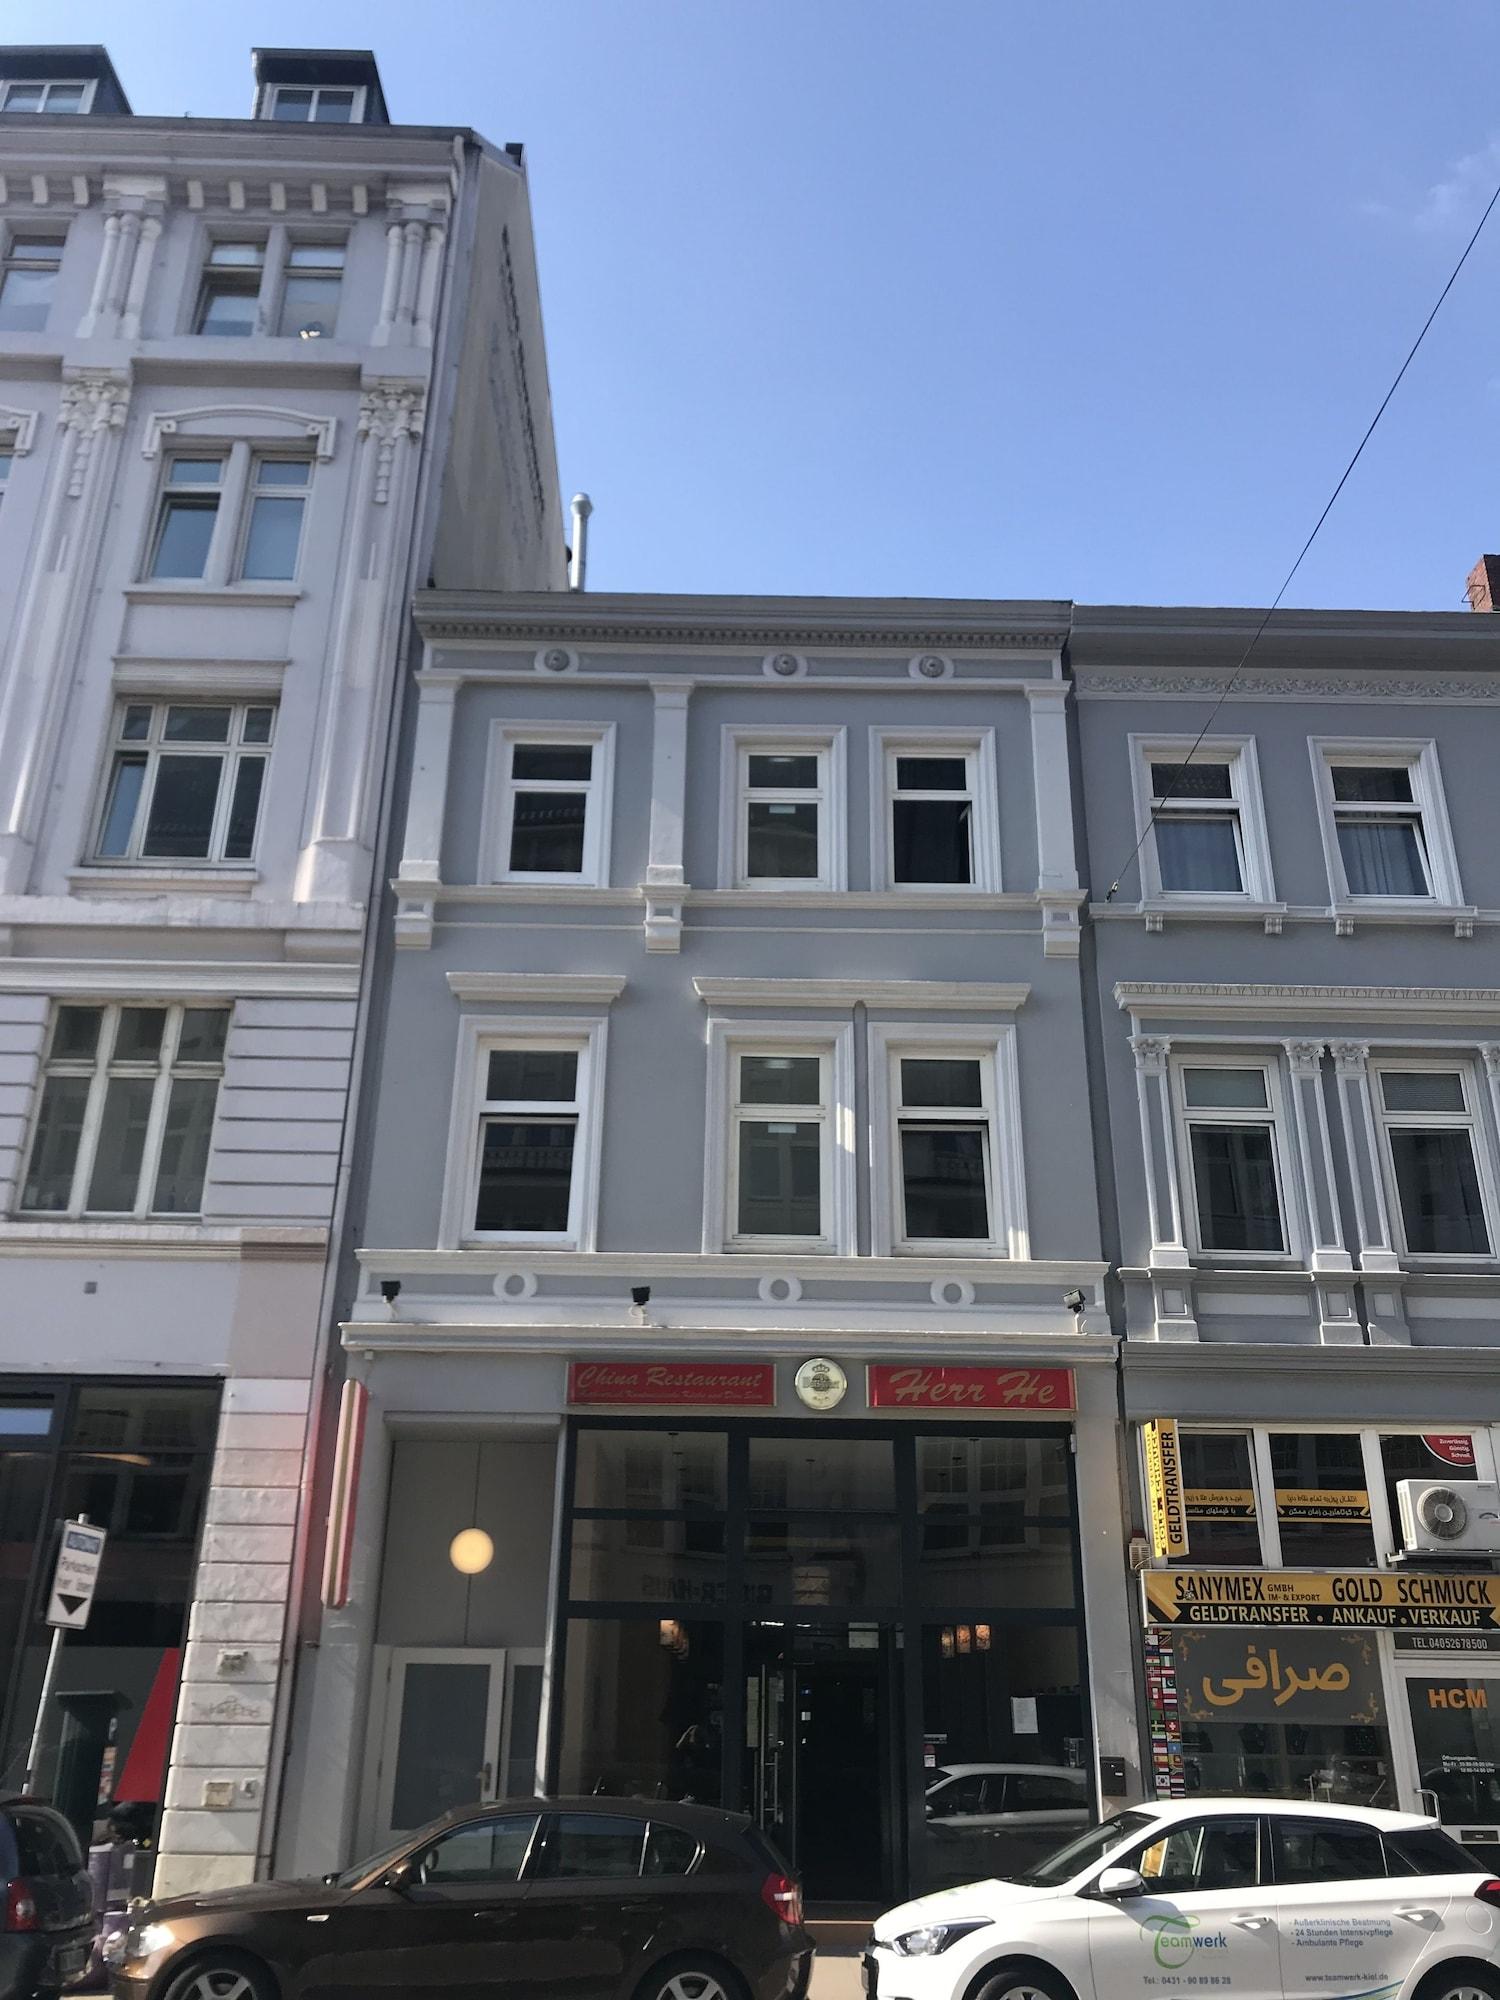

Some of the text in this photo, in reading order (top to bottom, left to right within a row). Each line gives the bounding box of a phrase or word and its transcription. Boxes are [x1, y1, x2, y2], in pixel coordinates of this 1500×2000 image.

[577, 1366, 763, 1388] China Restaurant
[890, 1369, 1056, 1403] Herr He
[1161, 1432, 1183, 1544] GELDTRANSFER
[1175, 1575, 1265, 1601] SANYMEX
[1267, 1584, 1294, 1592] GMBH
[1332, 1578, 1492, 1605] GOLD SCHMUCK
[1291, 1594, 1320, 1602] EXPORT
[1189, 1605, 1481, 1626] GELDTRANSFER ANKAUF VERKAUF
[1411, 1637, 1488, 1650] TEL.04052678500
[1202, 1645, 1350, 1706] صرافی
[1428, 1689, 1488, 1708] HCM
[1352, 1918, 1391, 1927] Beatmung
[1340, 1928, 1393, 1937] Intensivpflege
[1296, 1939, 1364, 1948] Ambulante Pflege
[1161, 1975, 1180, 1984] 0431
